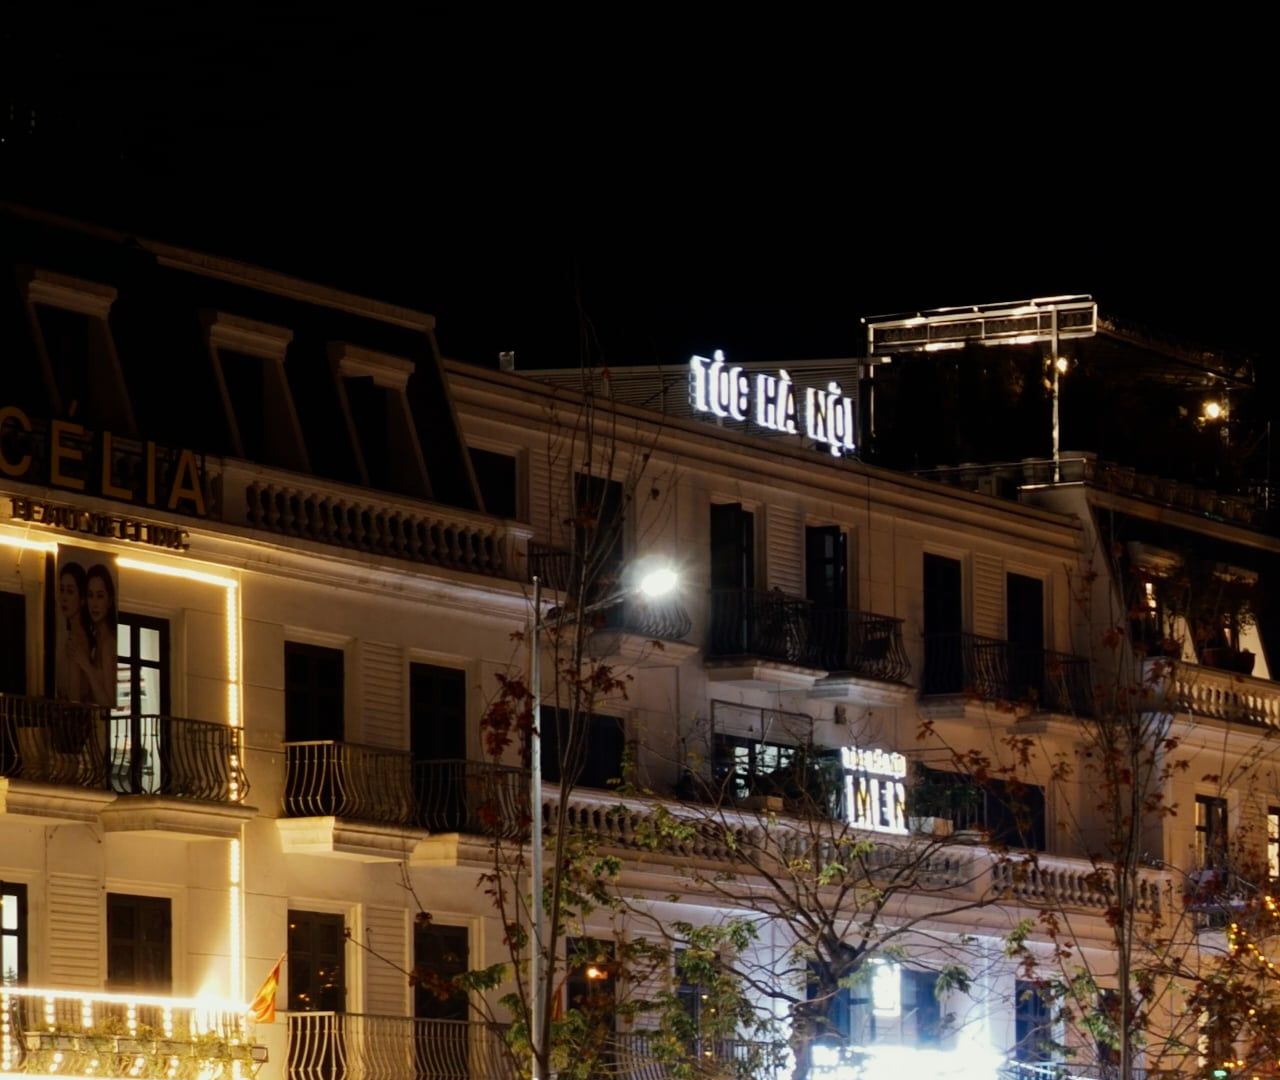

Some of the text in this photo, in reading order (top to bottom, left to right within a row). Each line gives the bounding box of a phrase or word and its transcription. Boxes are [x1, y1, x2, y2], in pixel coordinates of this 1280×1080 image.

[0, 399, 206, 515] CÉLIA
[689, 350, 856, 457] TÓC HÀ NỘI
